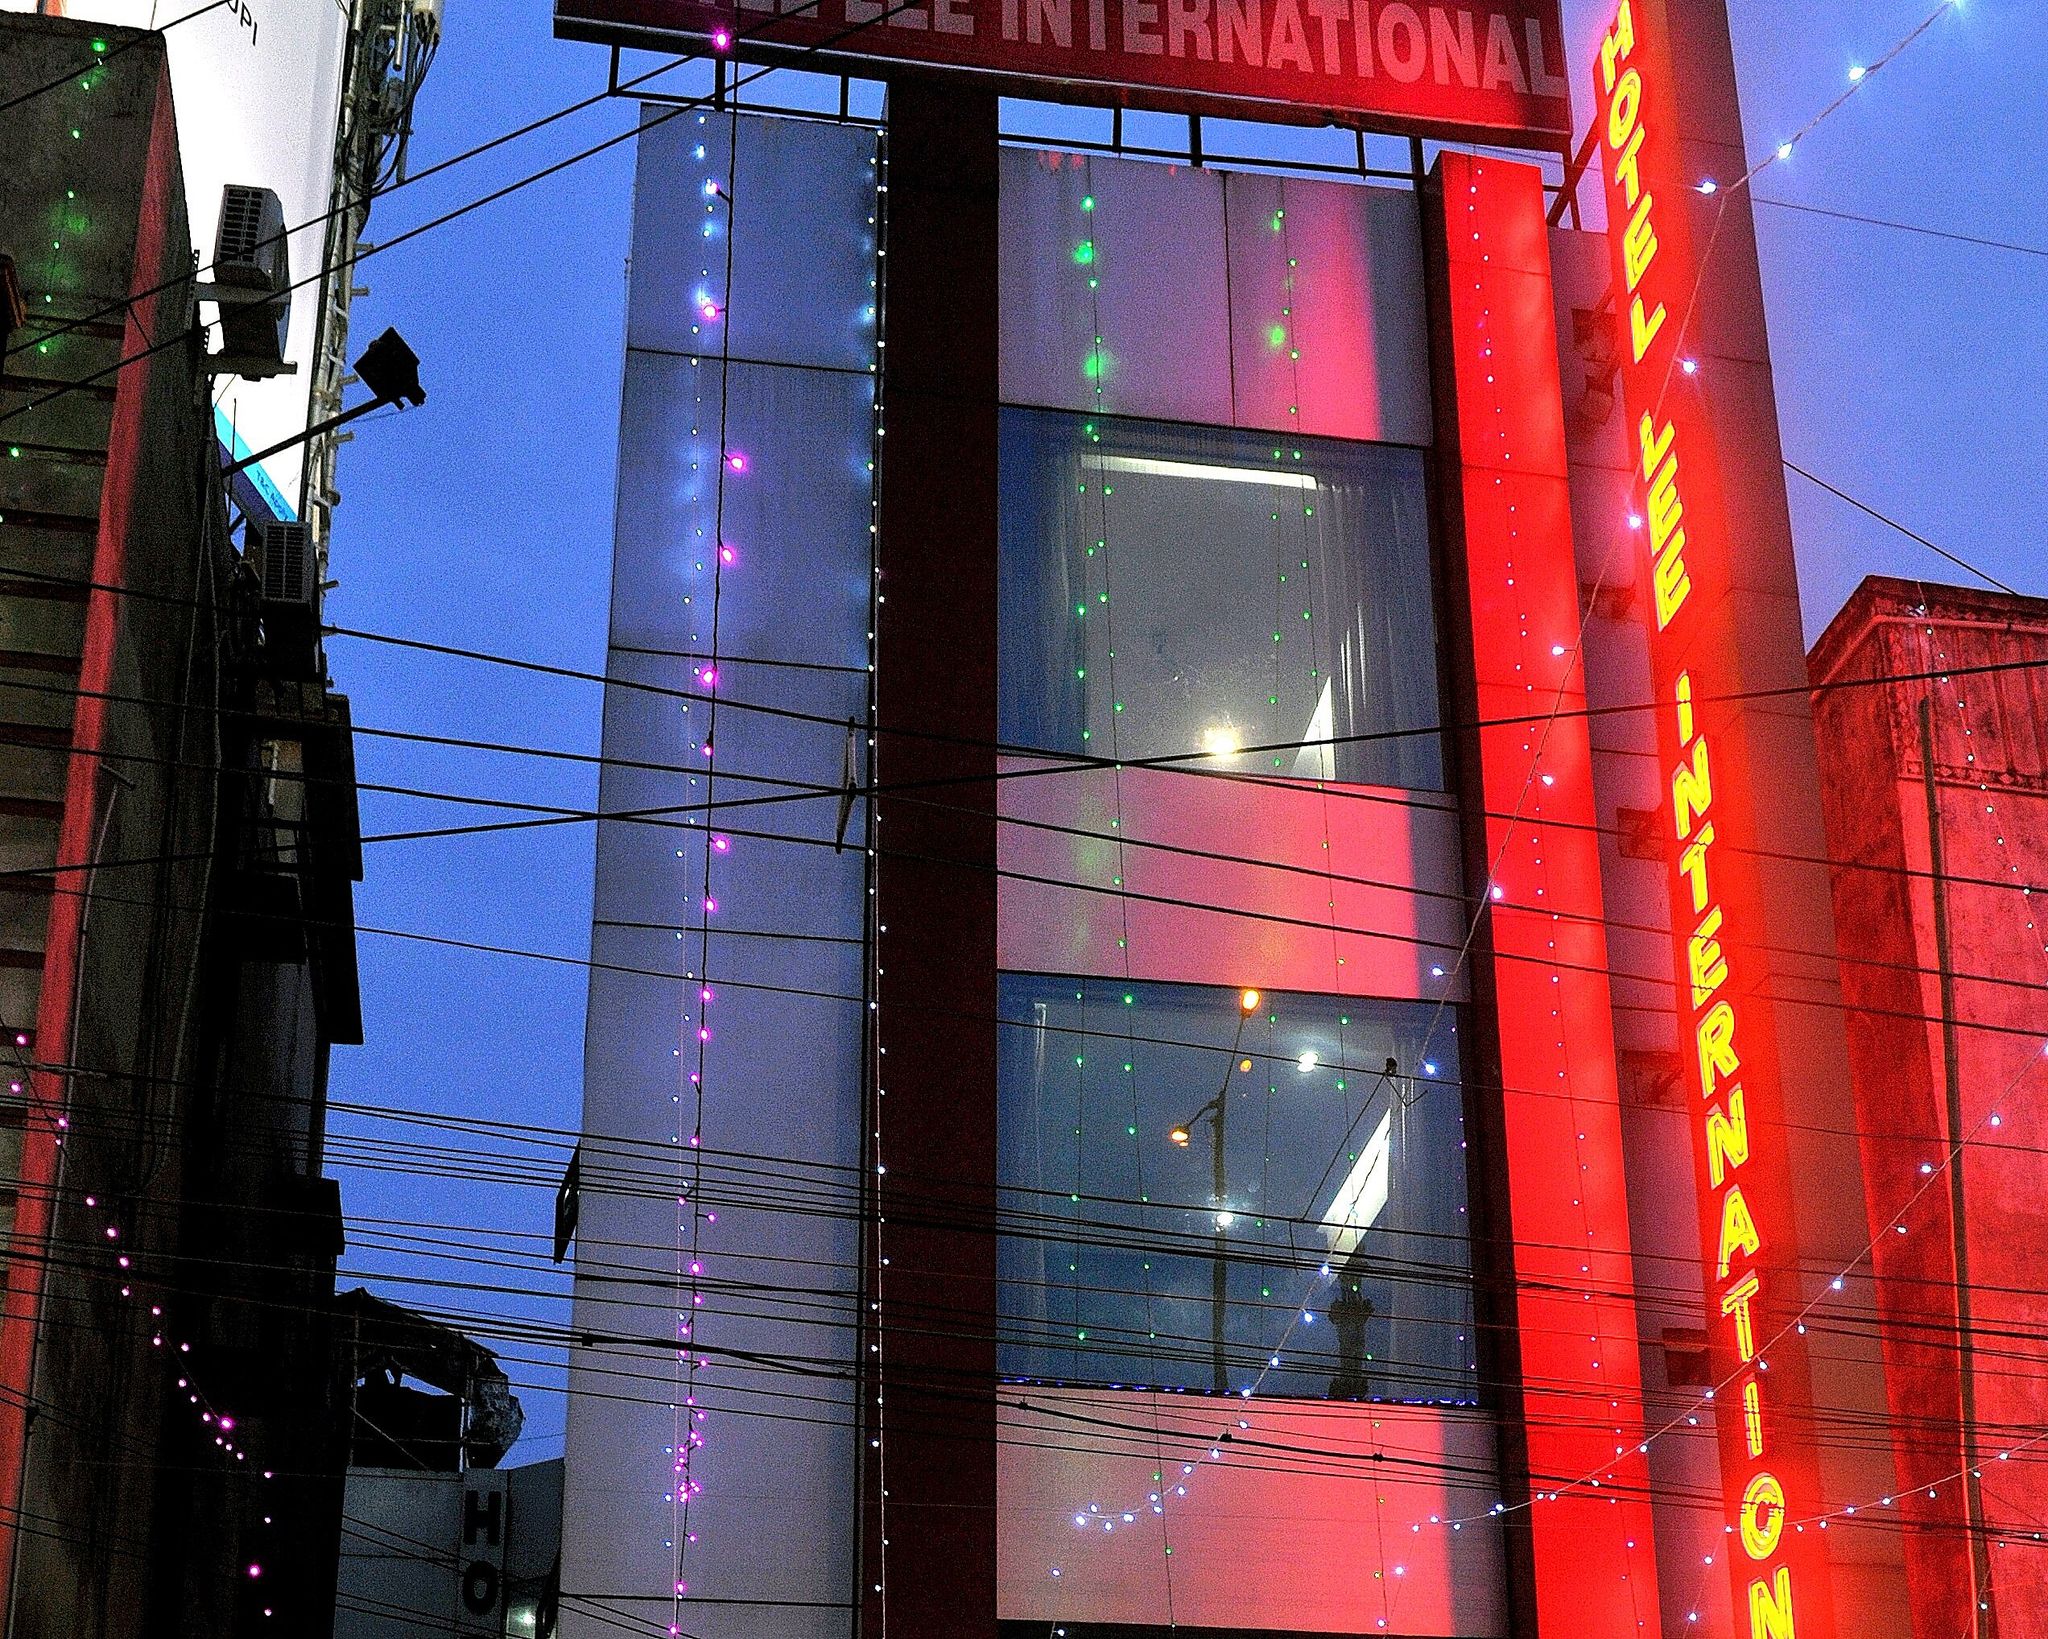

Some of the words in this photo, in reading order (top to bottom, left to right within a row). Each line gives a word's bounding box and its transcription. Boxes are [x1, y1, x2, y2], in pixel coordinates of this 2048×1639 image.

[1002, 0, 1566, 98] INTERNATIONAL
[1602, 0, 1666, 364] HOTEL
[1641, 409, 1690, 633] LEE
